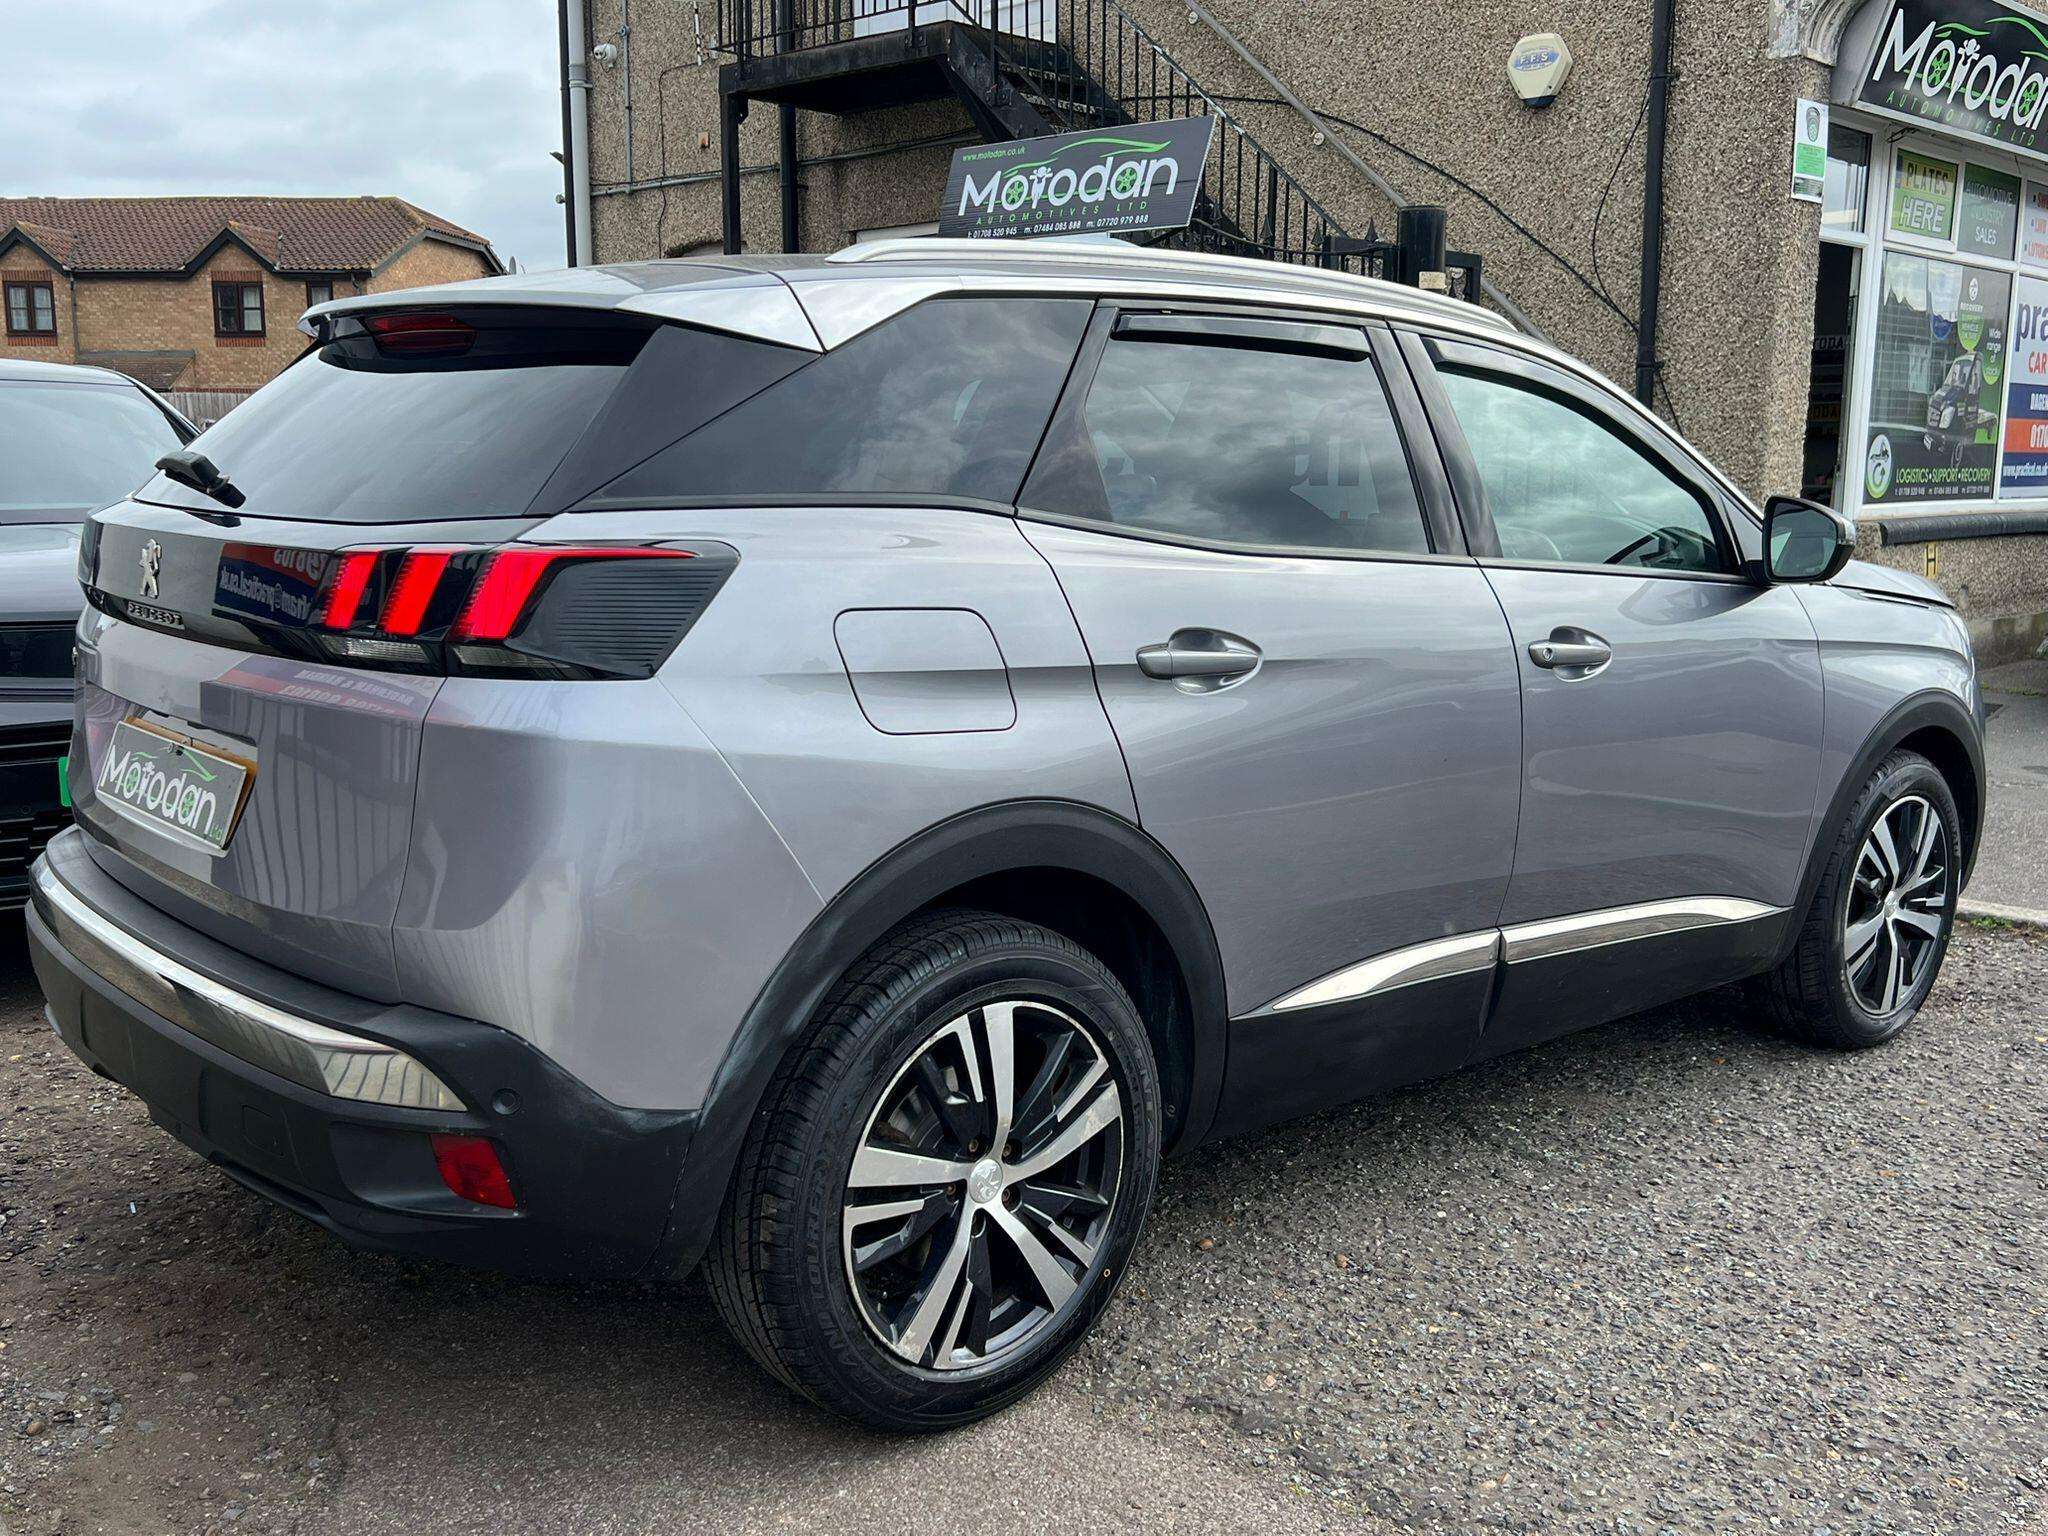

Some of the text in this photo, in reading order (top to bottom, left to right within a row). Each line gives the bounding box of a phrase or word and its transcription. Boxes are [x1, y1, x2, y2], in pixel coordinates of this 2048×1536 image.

[1886, 89, 2035, 147] AUTOMOTIVES LTD
[962, 146, 1026, 162] www.motodan.co.uk
[958, 156, 1179, 216] Motodan
[1906, 162, 1949, 196] PLATES
[976, 201, 1147, 225] AUTOMOTIVES LTD
[1033, 222, 1053, 233] 07484
[1096, 217, 1119, 228] 07720
[1120, 215, 1134, 225] 979
[1134, 214, 1149, 224] 888
[1899, 195, 1945, 233] HERE
[1974, 225, 1998, 245] SALES
[2028, 351, 2048, 375] CAR
[1896, 467, 1929, 484] LOGISTICS
[1932, 467, 1959, 483] SUPPORT
[1926, 543, 1938, 577] H
[128, 602, 183, 627] PEUGEOT
[100, 745, 216, 835] Motodan
